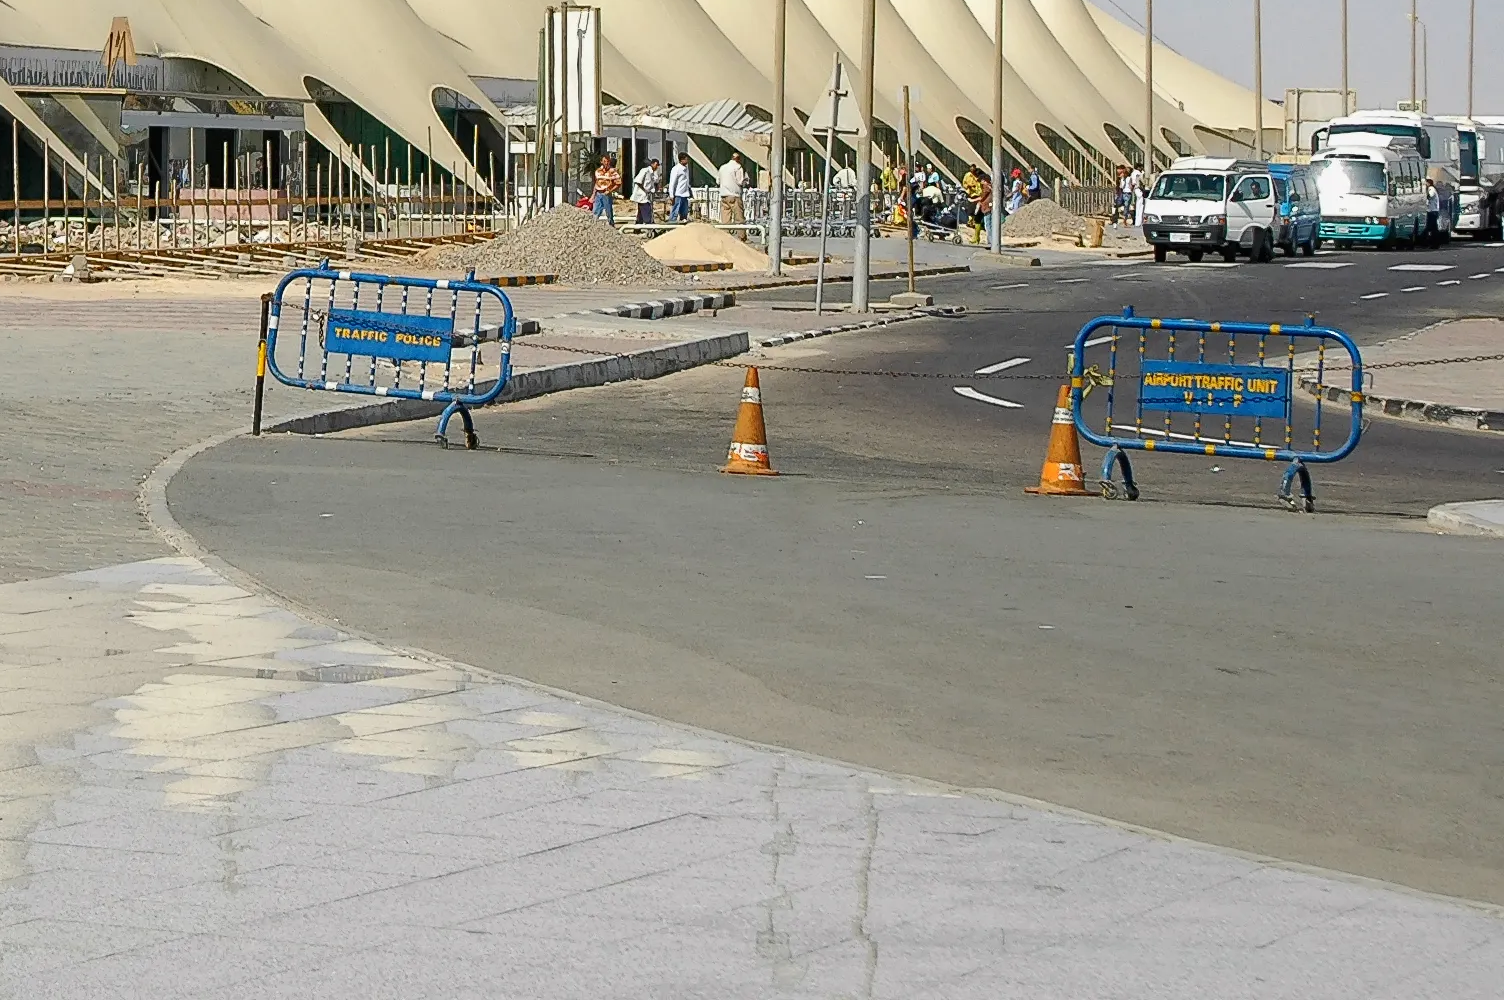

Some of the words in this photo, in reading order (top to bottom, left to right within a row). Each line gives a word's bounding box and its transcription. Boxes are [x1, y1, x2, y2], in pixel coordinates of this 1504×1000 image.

[334, 327, 388, 342] TRAFFIC
[395, 333, 441, 347] POLICE
[1144, 372, 1193, 388] AIRPORT
[1195, 374, 1244, 391] TRAFFIC
[1248, 378, 1278, 394] UNIT
